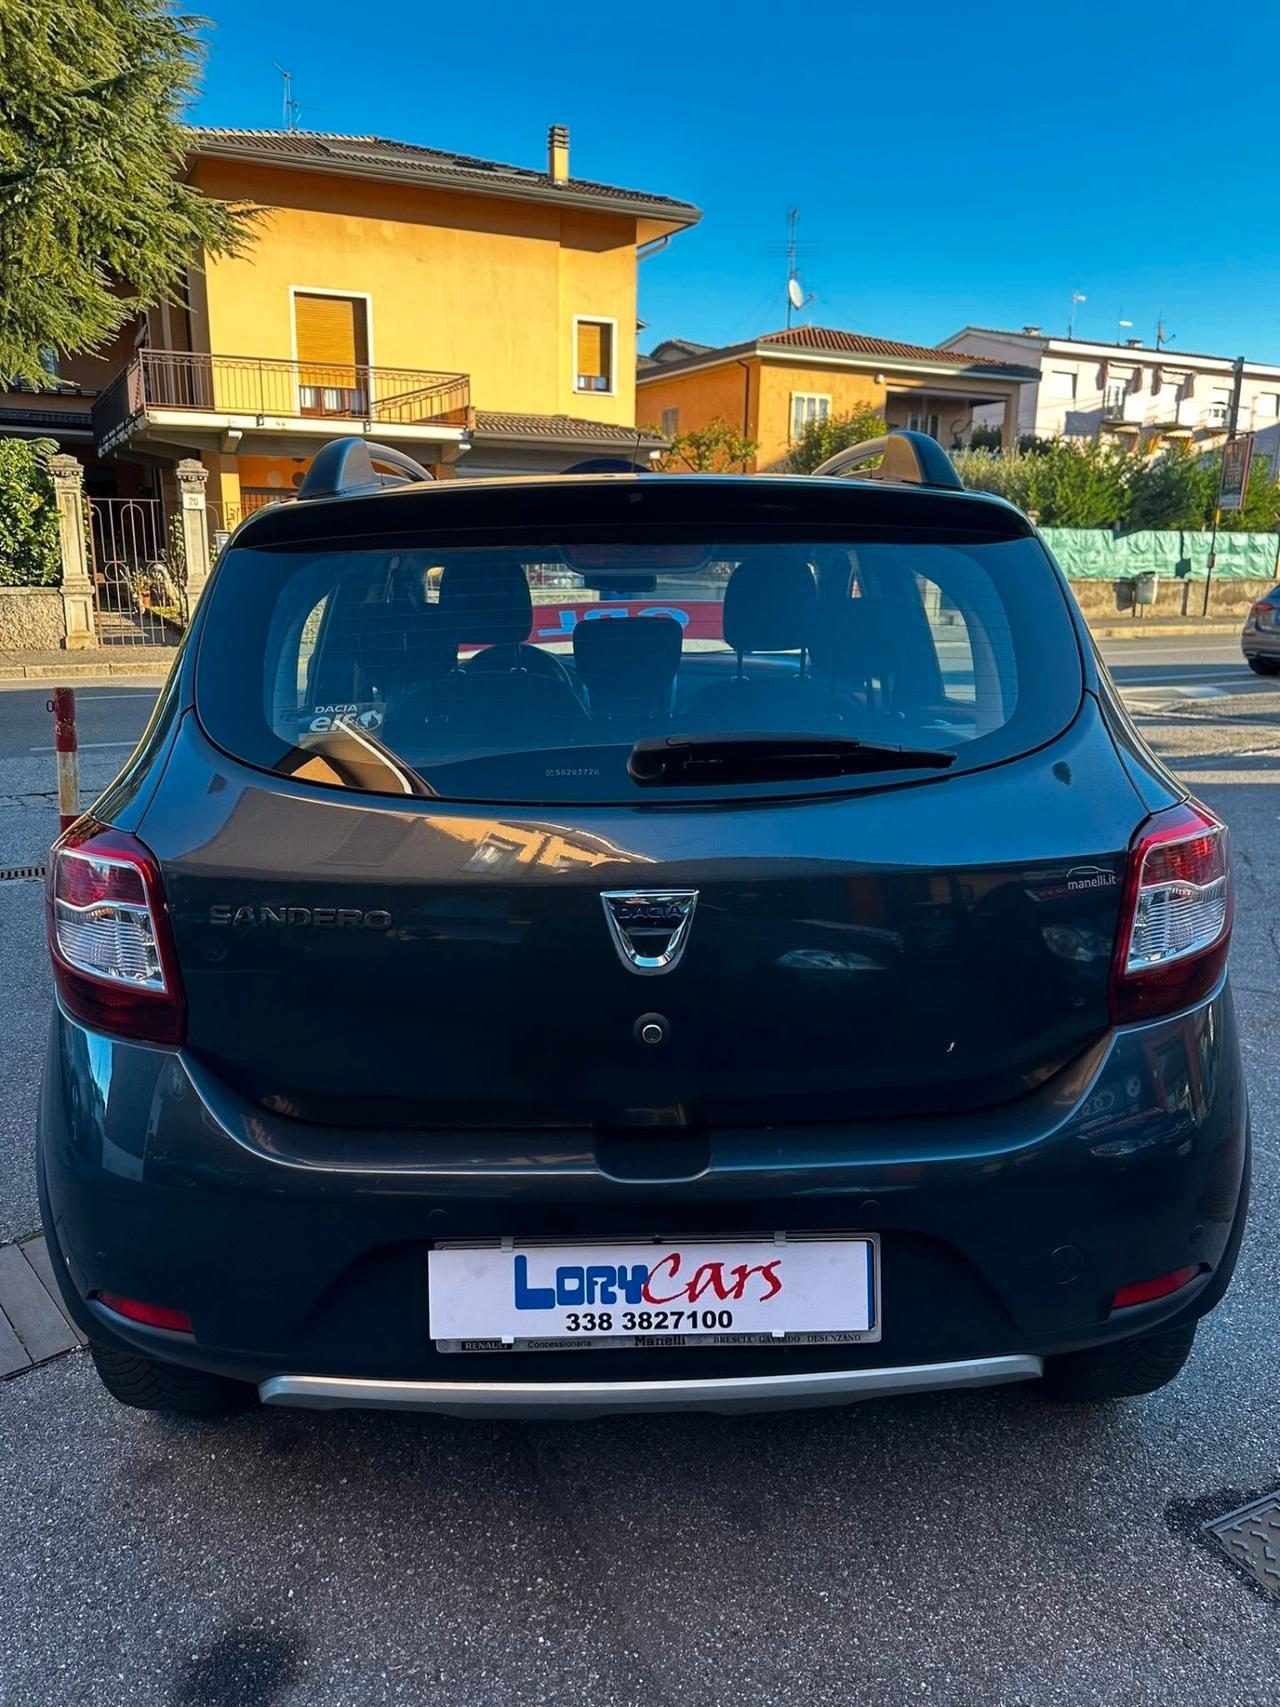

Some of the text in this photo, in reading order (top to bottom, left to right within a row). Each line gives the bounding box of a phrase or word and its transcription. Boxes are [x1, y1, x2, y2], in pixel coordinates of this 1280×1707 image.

[314, 704, 358, 714] DACIA
[1067, 874, 1118, 890] manelli.it
[209, 905, 393, 930] SANDERO
[618, 904, 682, 919] DACIA
[566, 1310, 733, 1331] 338 3827100
[527, 1340, 592, 1349] Concessionaria
[634, 1335, 686, 1347] Manelli
